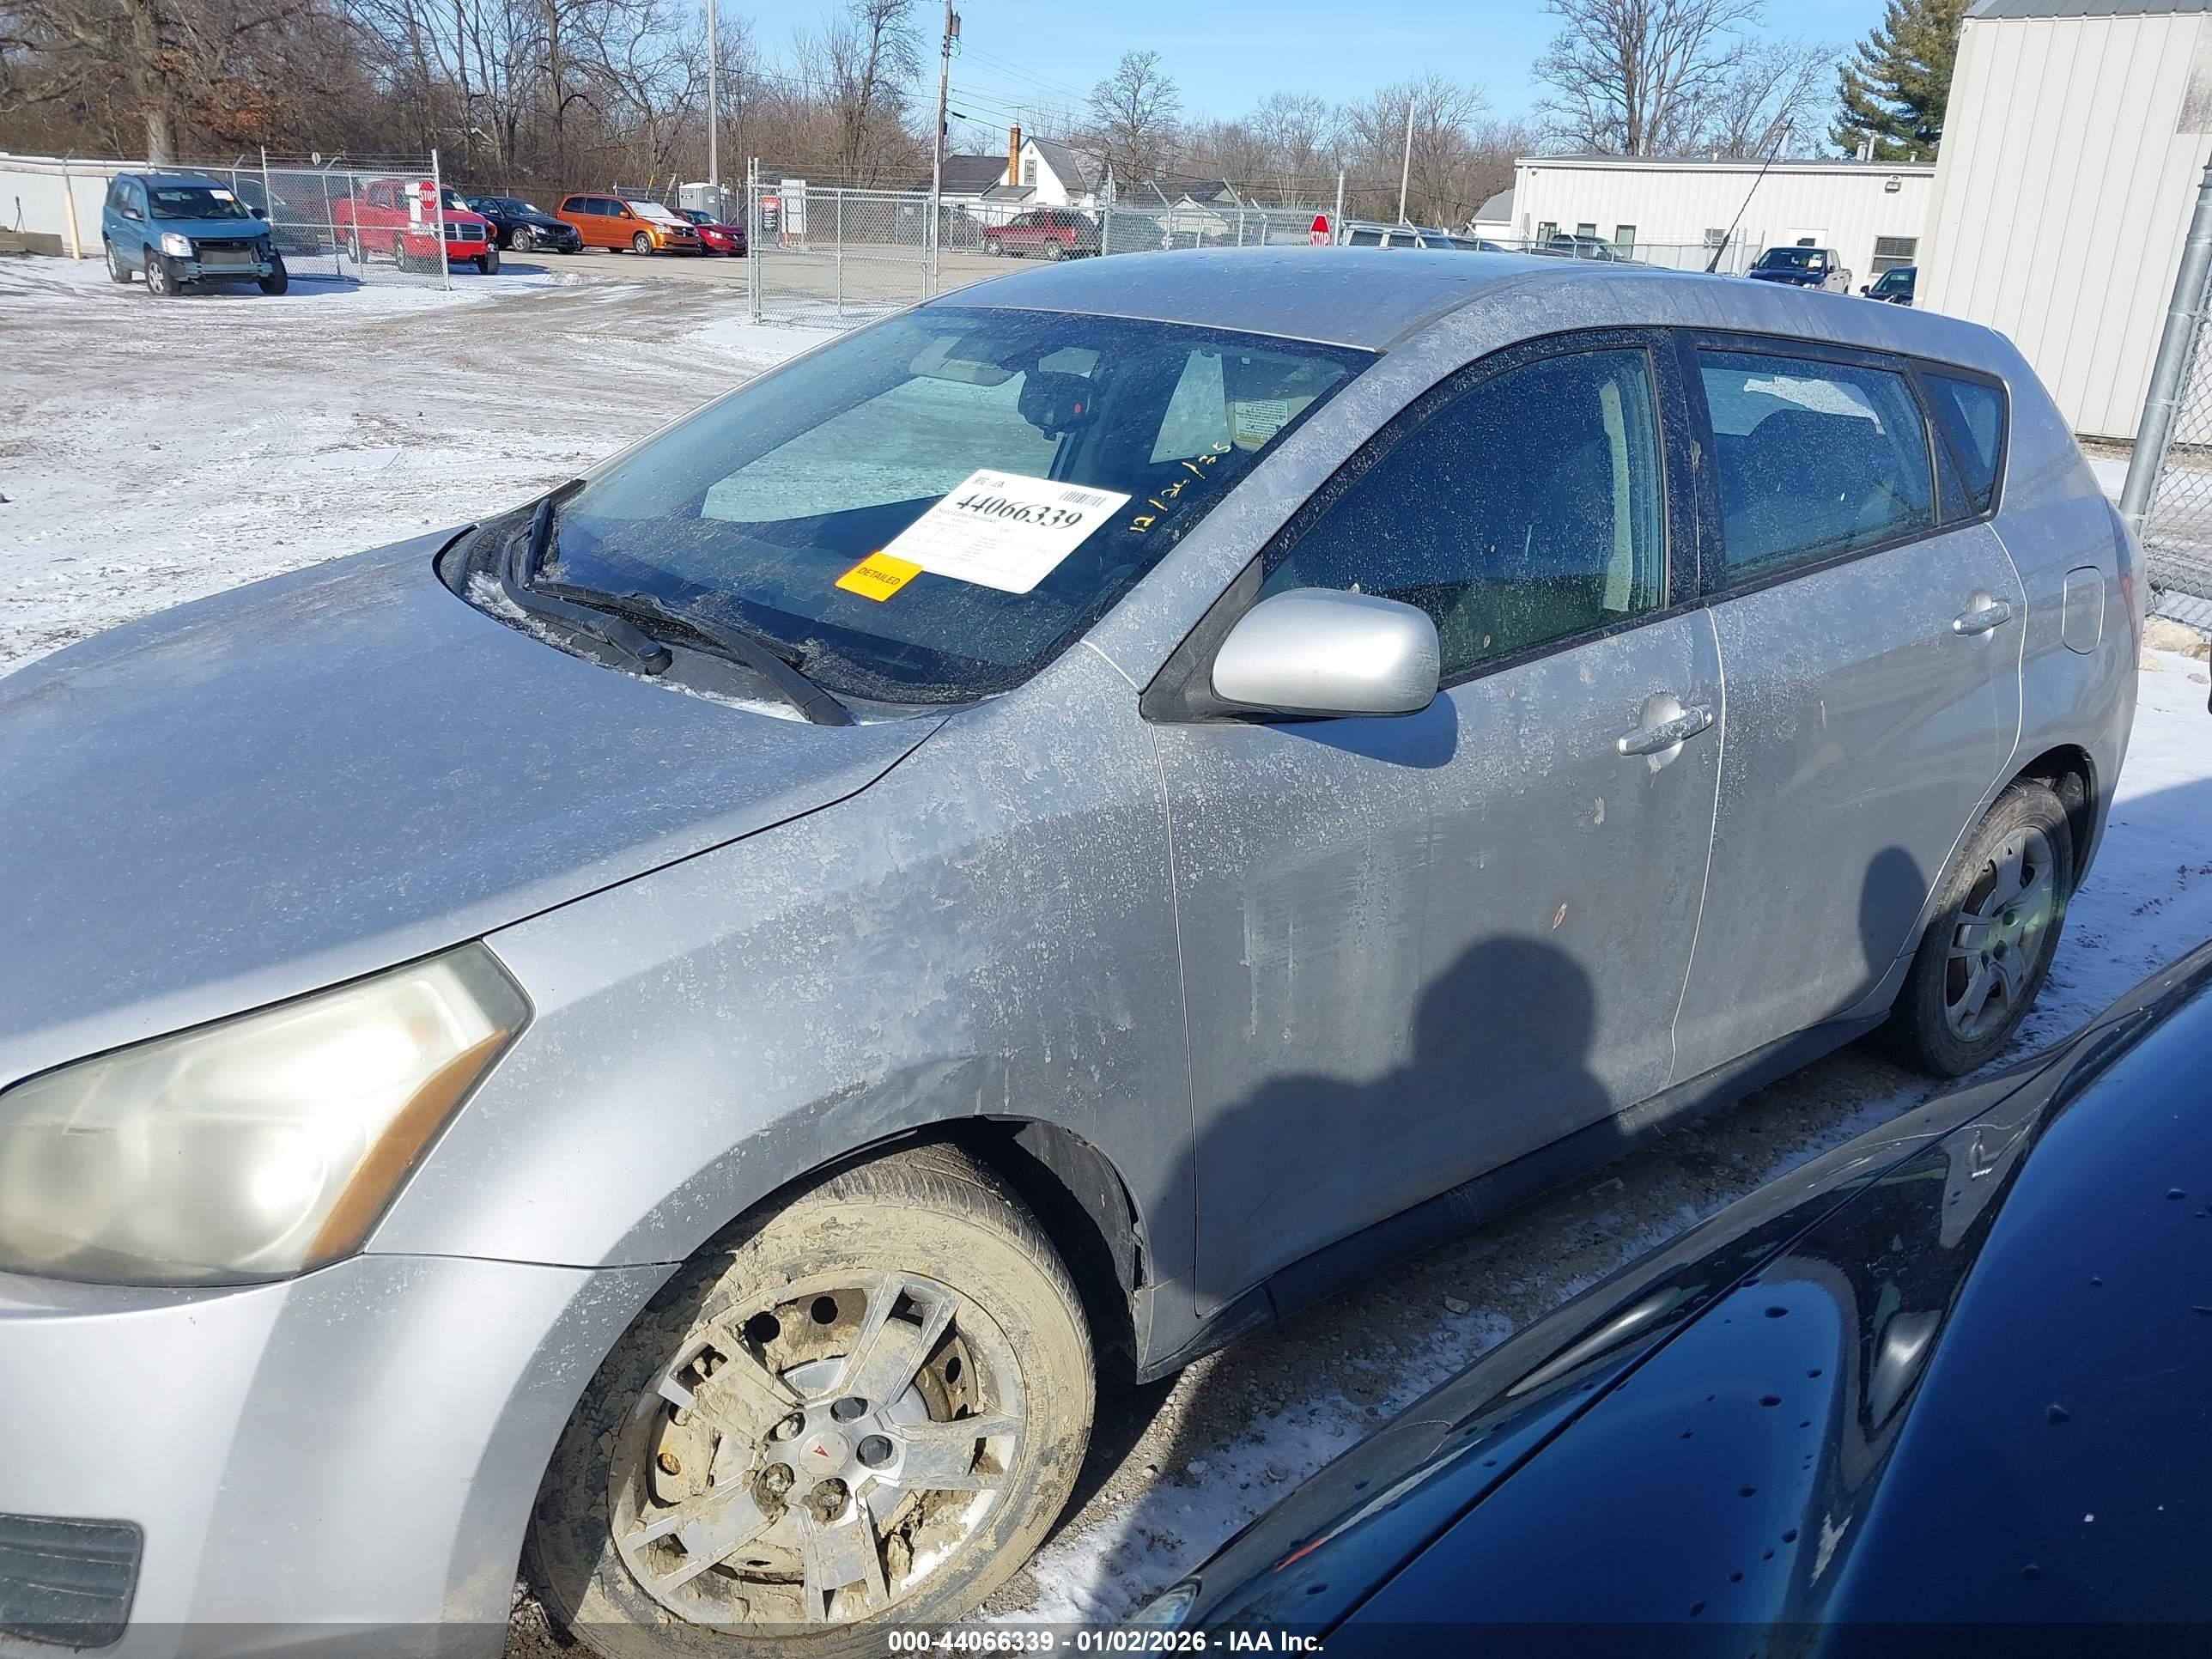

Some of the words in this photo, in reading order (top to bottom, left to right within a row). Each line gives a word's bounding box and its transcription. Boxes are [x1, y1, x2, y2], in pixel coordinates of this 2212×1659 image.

[419, 189, 436, 202] STOP
[1310, 231, 1329, 246] STOP
[956, 493, 1083, 529] 44066339
[857, 567, 901, 585] DETAILED
